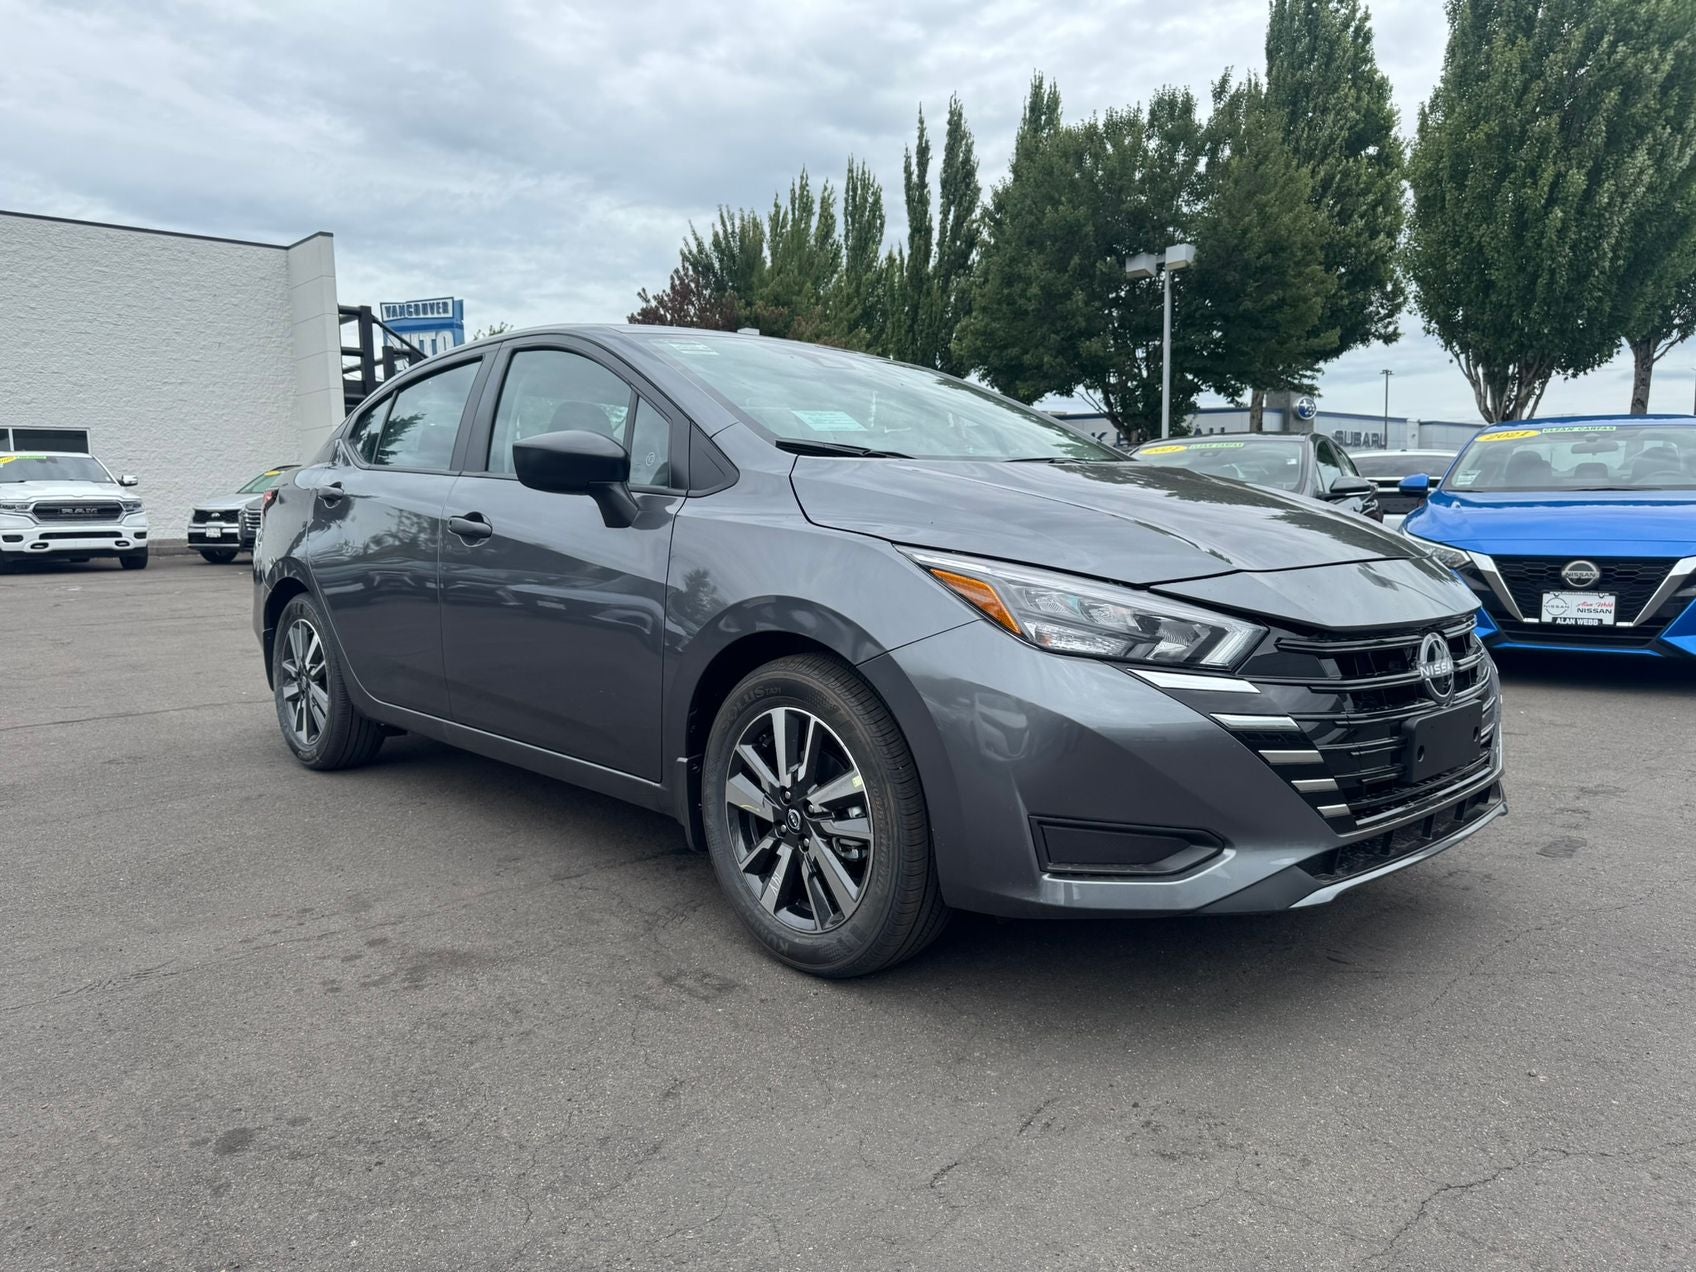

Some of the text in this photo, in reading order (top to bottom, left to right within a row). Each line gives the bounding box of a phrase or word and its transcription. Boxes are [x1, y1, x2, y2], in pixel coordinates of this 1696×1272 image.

[385, 301, 449, 318] VANCOUVER
[1334, 430, 1388, 449] SUBARU
[60, 507, 99, 515] RAM
[1577, 618, 1599, 626] WEBB
